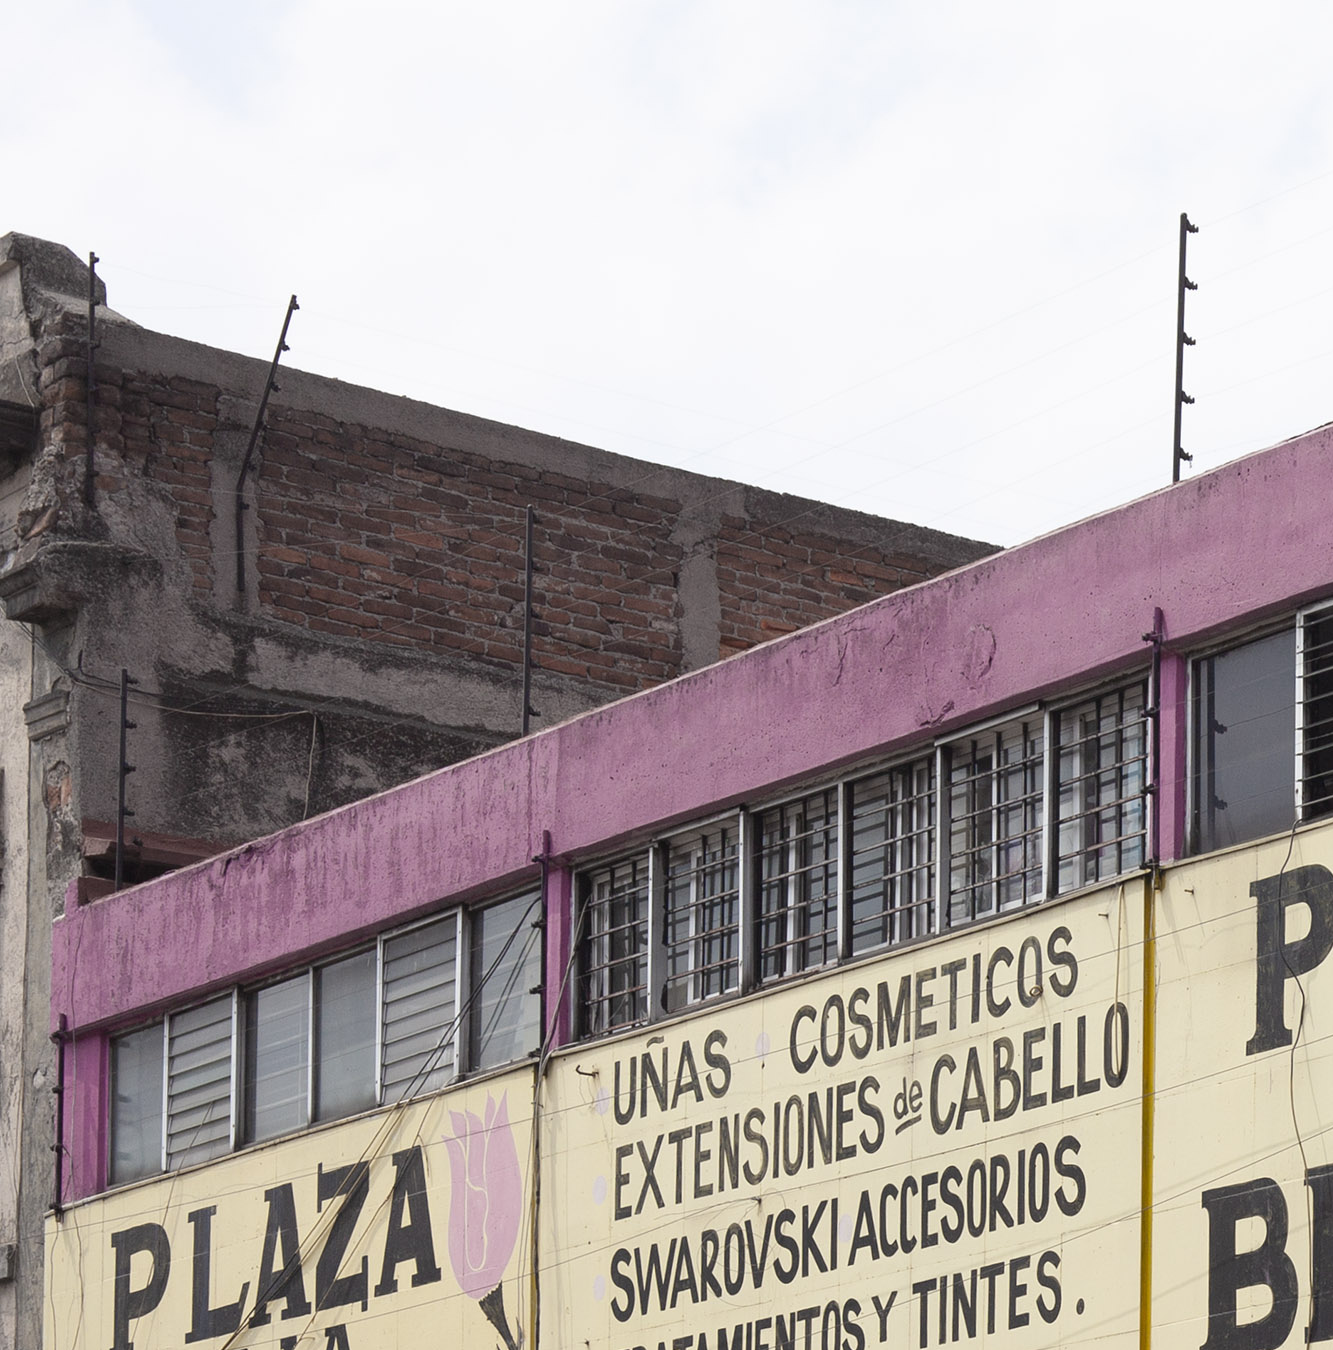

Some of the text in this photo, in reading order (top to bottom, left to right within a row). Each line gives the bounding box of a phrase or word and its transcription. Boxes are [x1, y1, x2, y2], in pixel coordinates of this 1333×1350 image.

[614, 926, 1079, 1125] UÑAS COSMETICOS
[614, 1002, 1130, 1220] EXTENSIONES de CABELLO
[610, 1135, 1087, 1323] SWAROVSKI ACCESORIOS
[871, 1292, 898, 1343] Y
